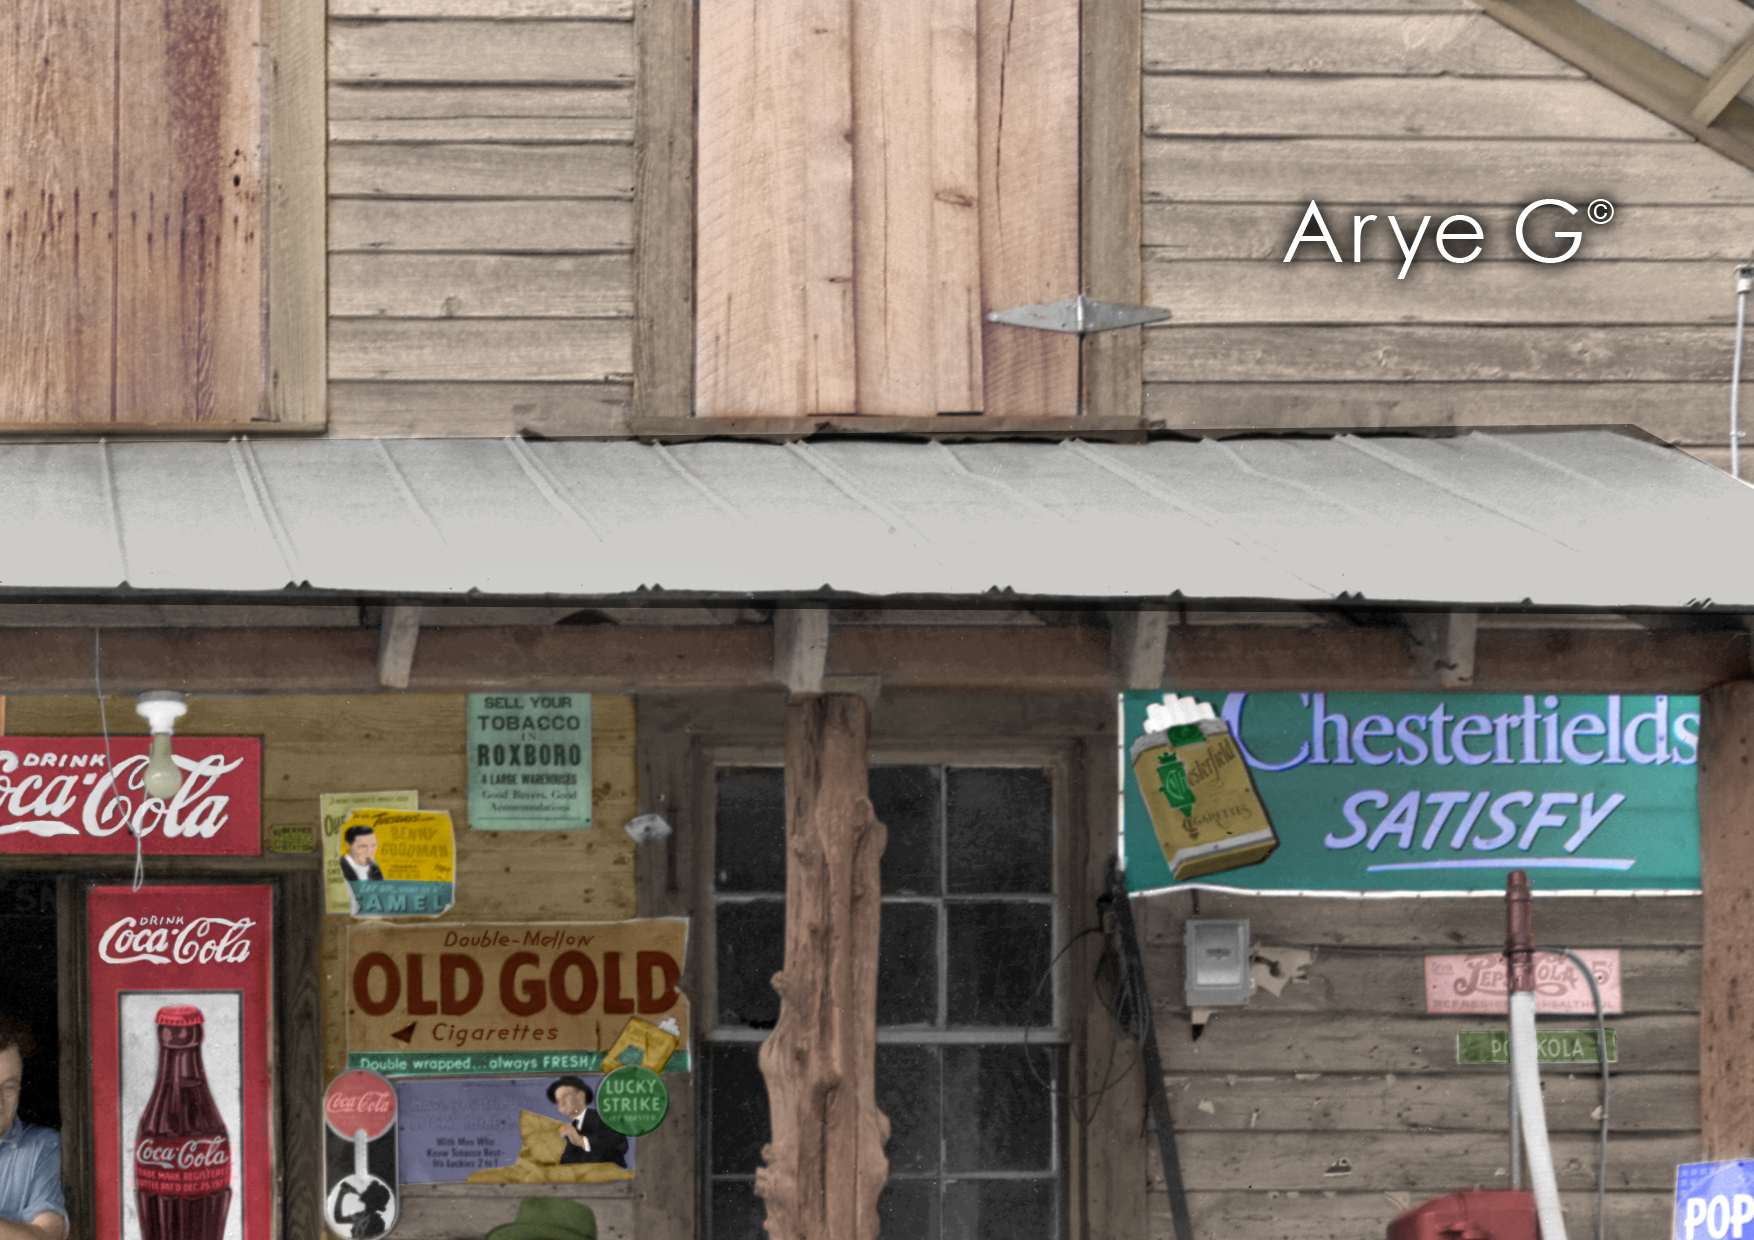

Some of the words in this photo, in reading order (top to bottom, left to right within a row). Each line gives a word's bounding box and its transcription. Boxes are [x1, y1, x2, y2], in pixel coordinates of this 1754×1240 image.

[484, 696, 525, 710] SELL
[530, 696, 572, 709] YOUR
[477, 715, 581, 731] TOBACCO
[521, 732, 536, 741] IN
[1221, 691, 1701, 773] Chesterfields
[22, 752, 107, 769] DRINK
[477, 743, 582, 767] ROXBORO
[489, 773, 518, 785] LARGE
[521, 773, 577, 785] WAREHOUSES
[482, 789, 508, 799] Good
[551, 789, 577, 800] Good
[1324, 788, 1626, 854] SATISFY
[139, 915, 184, 926] DRINK
[98, 916, 257, 965] Coca-Cola
[353, 951, 484, 1016] OLD
[499, 950, 681, 1017] GOLD
[432, 1022, 558, 1047] Cigarettes
[360, 1057, 407, 1071] Double
[489, 1057, 538, 1072] always
[543, 1054, 597, 1071] FRESH!
[606, 1079, 657, 1095] LUCKY
[326, 1091, 390, 1113] Coca-Cola
[602, 1097, 660, 1112] STRIKE
[436, 1137, 455, 1146] With
[457, 1137, 475, 1146] Men
[477, 1137, 495, 1146] Who
[136, 1135, 229, 1170] Coca-Cola
[426, 1149, 449, 1158] Know
[450, 1148, 481, 1158] Tobacco
[446, 1158, 475, 1168] Luckies
[477, 1158, 484, 1168] 2
[484, 1159, 492, 1168] to
[1684, 1193, 1754, 1240] POP
